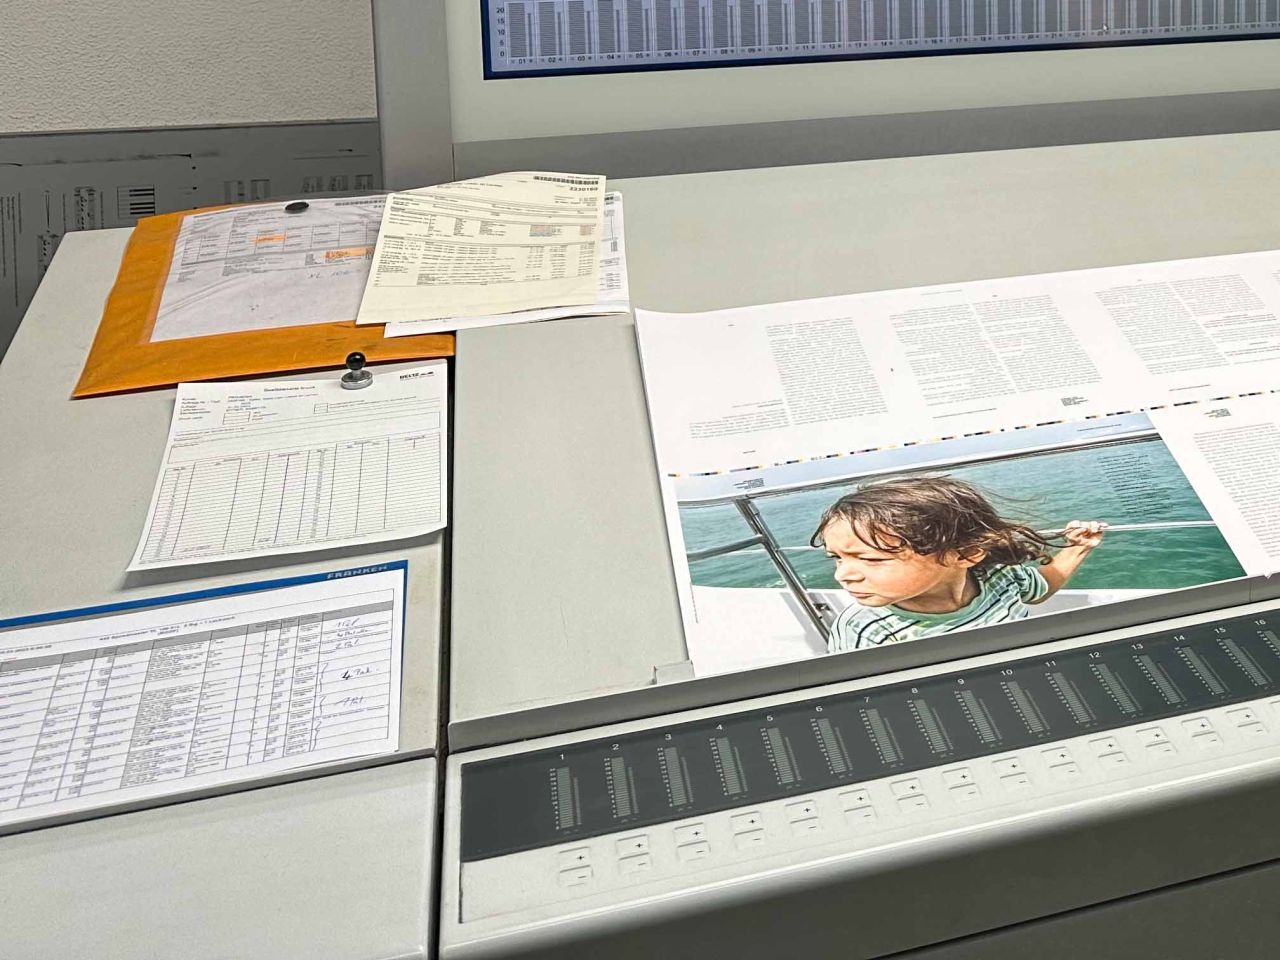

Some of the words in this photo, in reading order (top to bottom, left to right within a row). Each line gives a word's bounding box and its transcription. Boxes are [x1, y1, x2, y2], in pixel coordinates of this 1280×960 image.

[326, 565, 388, 579] FRANKEN
[559, 753, 565, 761] 1
[612, 743, 620, 751] 2
[665, 733, 672, 741] 3
[815, 705, 823, 713] 6
[863, 696, 870, 704] 7
[1001, 668, 1013, 677] 10
[1045, 660, 1057, 668] 11
[1088, 651, 1101, 659] 12
[1131, 643, 1144, 651] 13
[1174, 634, 1186, 643] 14
[1213, 626, 1226, 634] 15
[1254, 618, 1267, 627] 16
